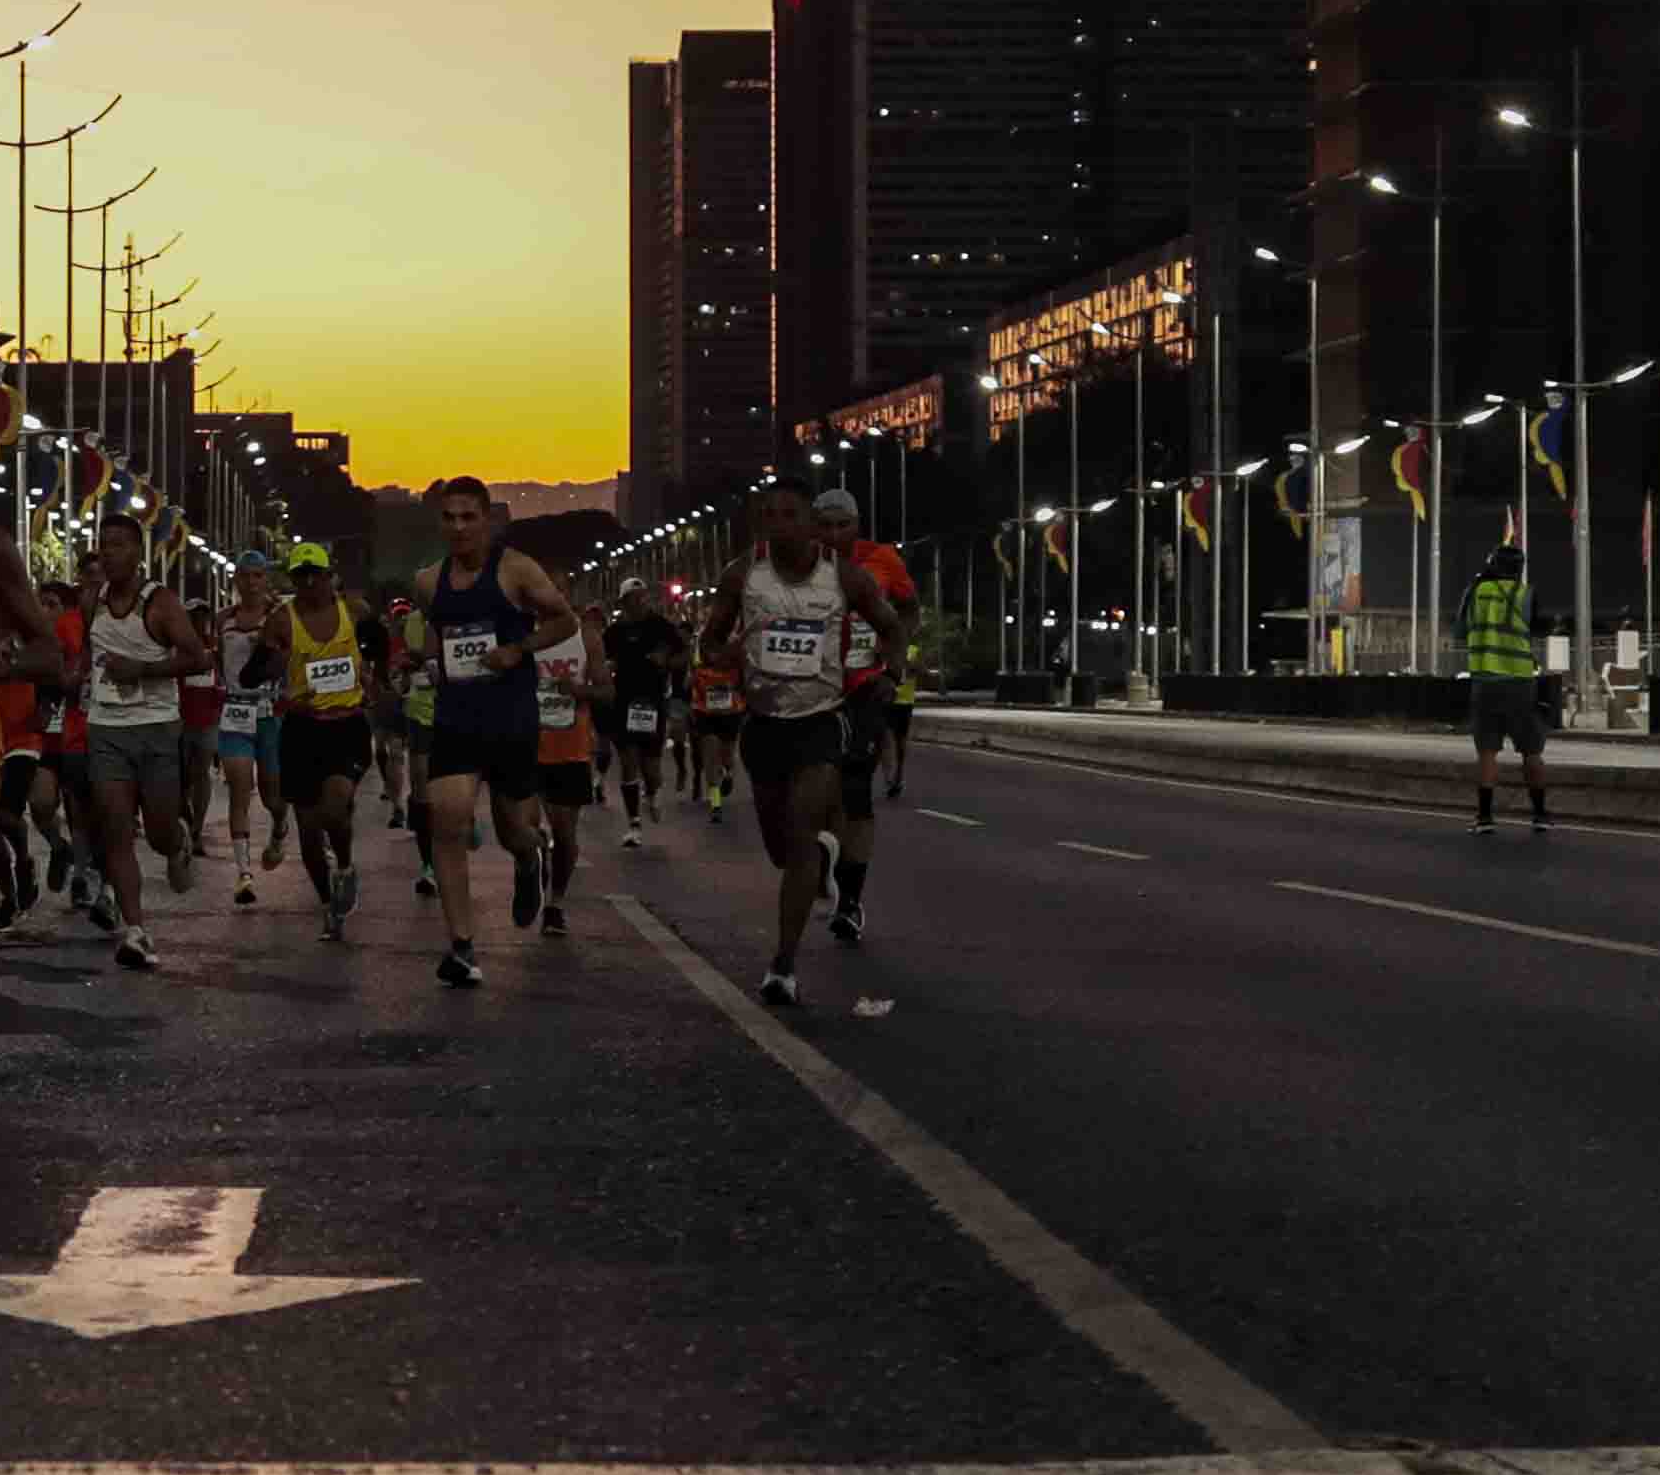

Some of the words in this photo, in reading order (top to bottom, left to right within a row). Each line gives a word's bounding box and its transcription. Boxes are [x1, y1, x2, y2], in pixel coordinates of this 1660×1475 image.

[453, 641, 489, 658] 502
[765, 638, 818, 655] 1512
[310, 661, 350, 680] 1230
